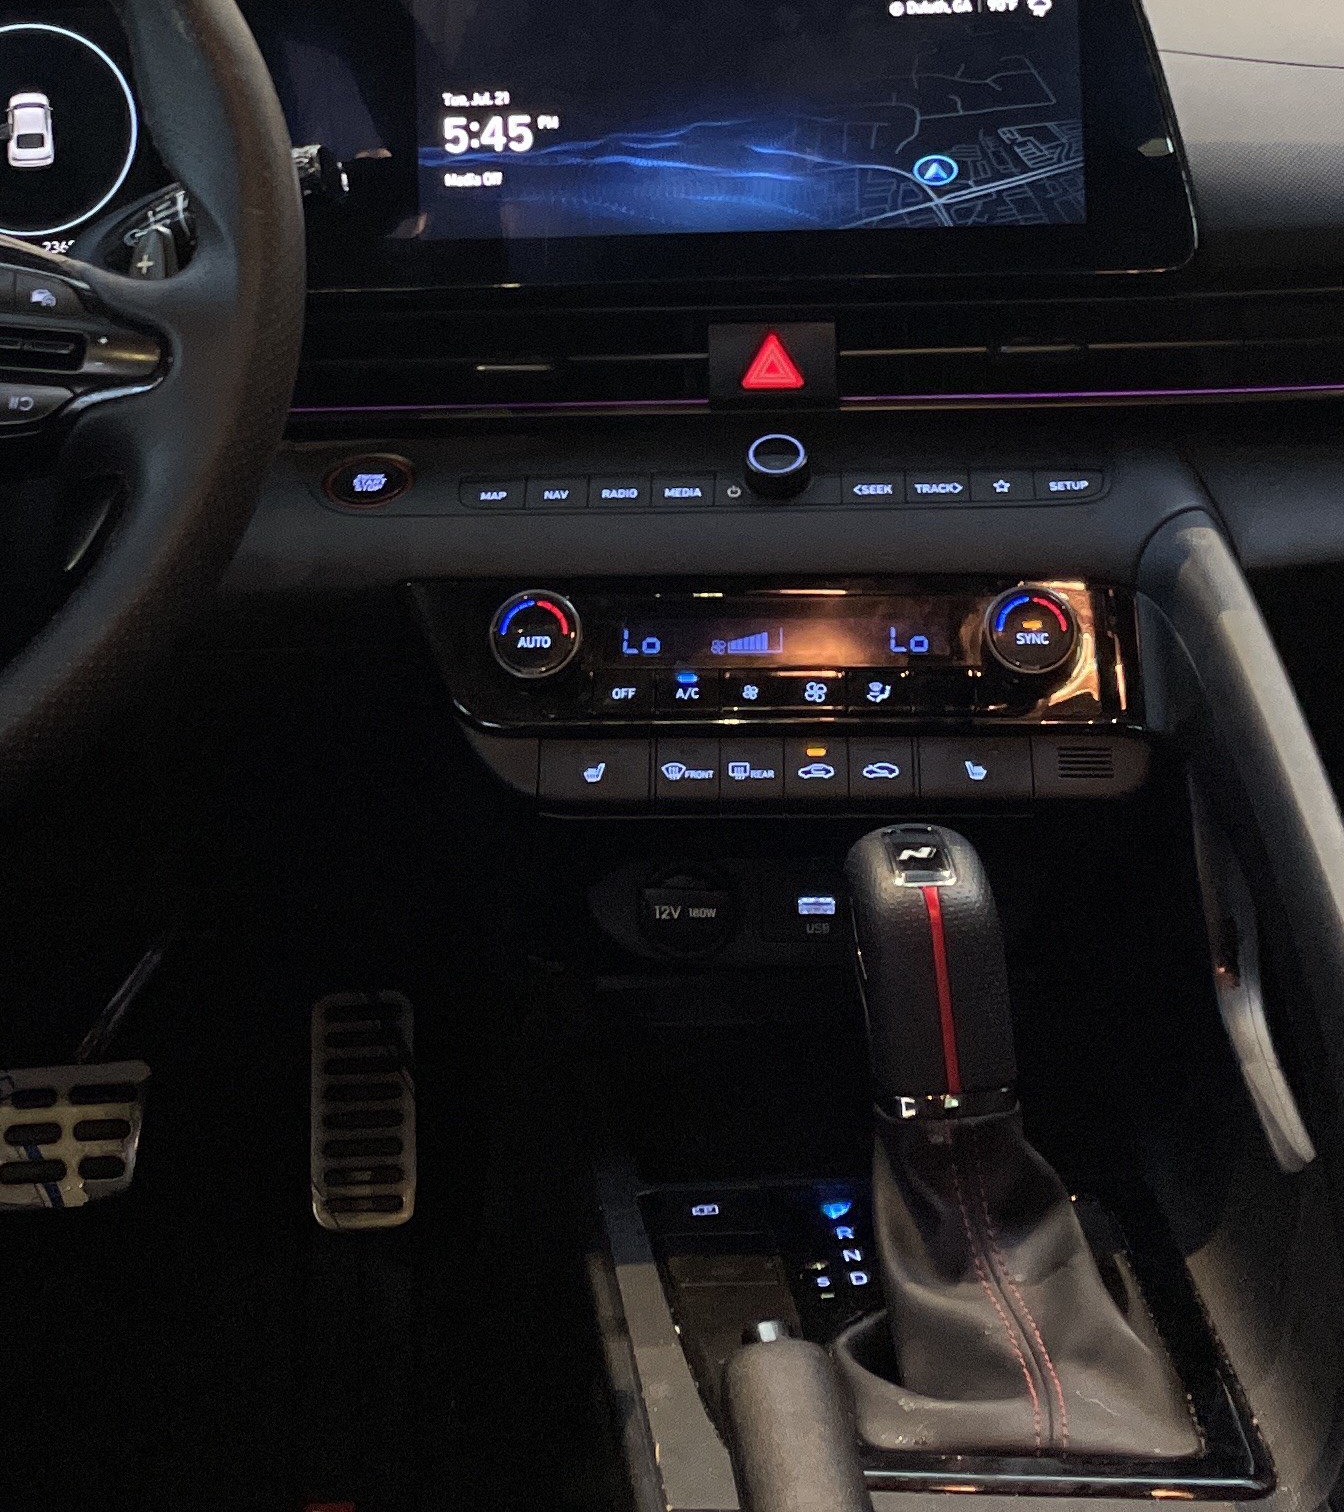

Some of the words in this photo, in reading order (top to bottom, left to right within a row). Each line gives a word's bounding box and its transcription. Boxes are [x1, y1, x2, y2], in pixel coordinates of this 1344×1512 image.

[443, 114, 534, 155] 5:45
[664, 487, 702, 498] MEDIA
[1048, 480, 1089, 492] SETUP
[479, 491, 507, 501] MAP
[543, 489, 570, 500] NAV
[601, 488, 639, 499] RADIO
[517, 636, 552, 649] AUTO
[1016, 632, 1050, 645] SYNC
[611, 687, 637, 700] OFF
[676, 687, 700, 700] A/C
[684, 767, 714, 780] FRONT
[750, 768, 775, 779] REAR
[654, 905, 682, 920] 12V
[806, 922, 830, 934] USB
[835, 1225, 855, 1240] R
[842, 1248, 862, 1262] N
[816, 1275, 831, 1287] S
[849, 1270, 868, 1286] D
